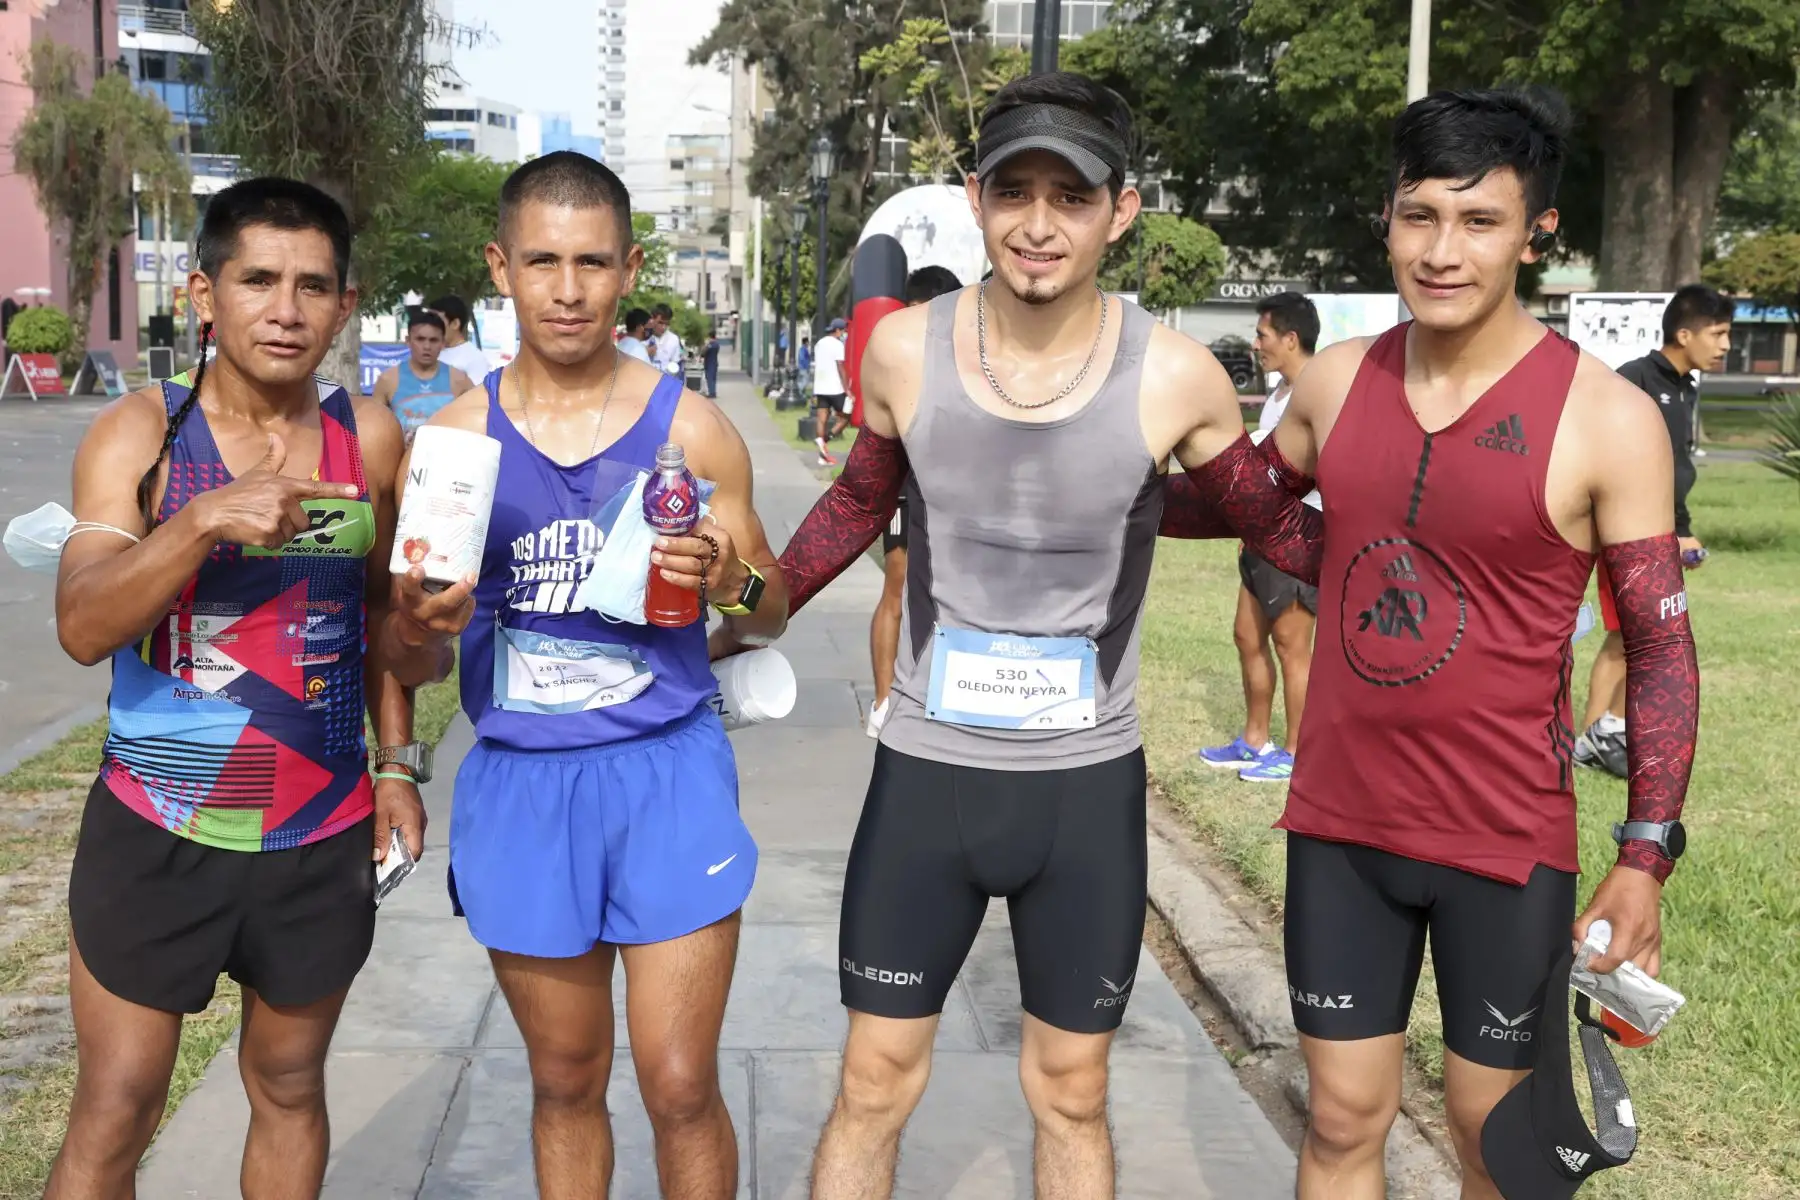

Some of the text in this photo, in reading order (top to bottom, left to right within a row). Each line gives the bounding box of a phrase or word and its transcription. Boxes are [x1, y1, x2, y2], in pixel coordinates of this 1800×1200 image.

[1474, 435, 1529, 456] adidas
[282, 546, 311, 554] FONDO
[325, 547, 353, 555] CALIDAD
[510, 519, 605, 561] 109 MEDI
[510, 553, 596, 583] MARAT
[194, 664, 236, 672] MONTAÑA
[995, 669, 1028, 681] 530
[957, 679, 1067, 696] OLEDON NEYRA
[842, 957, 924, 986] OLEDON
[1555, 1145, 1582, 1173] adidas
